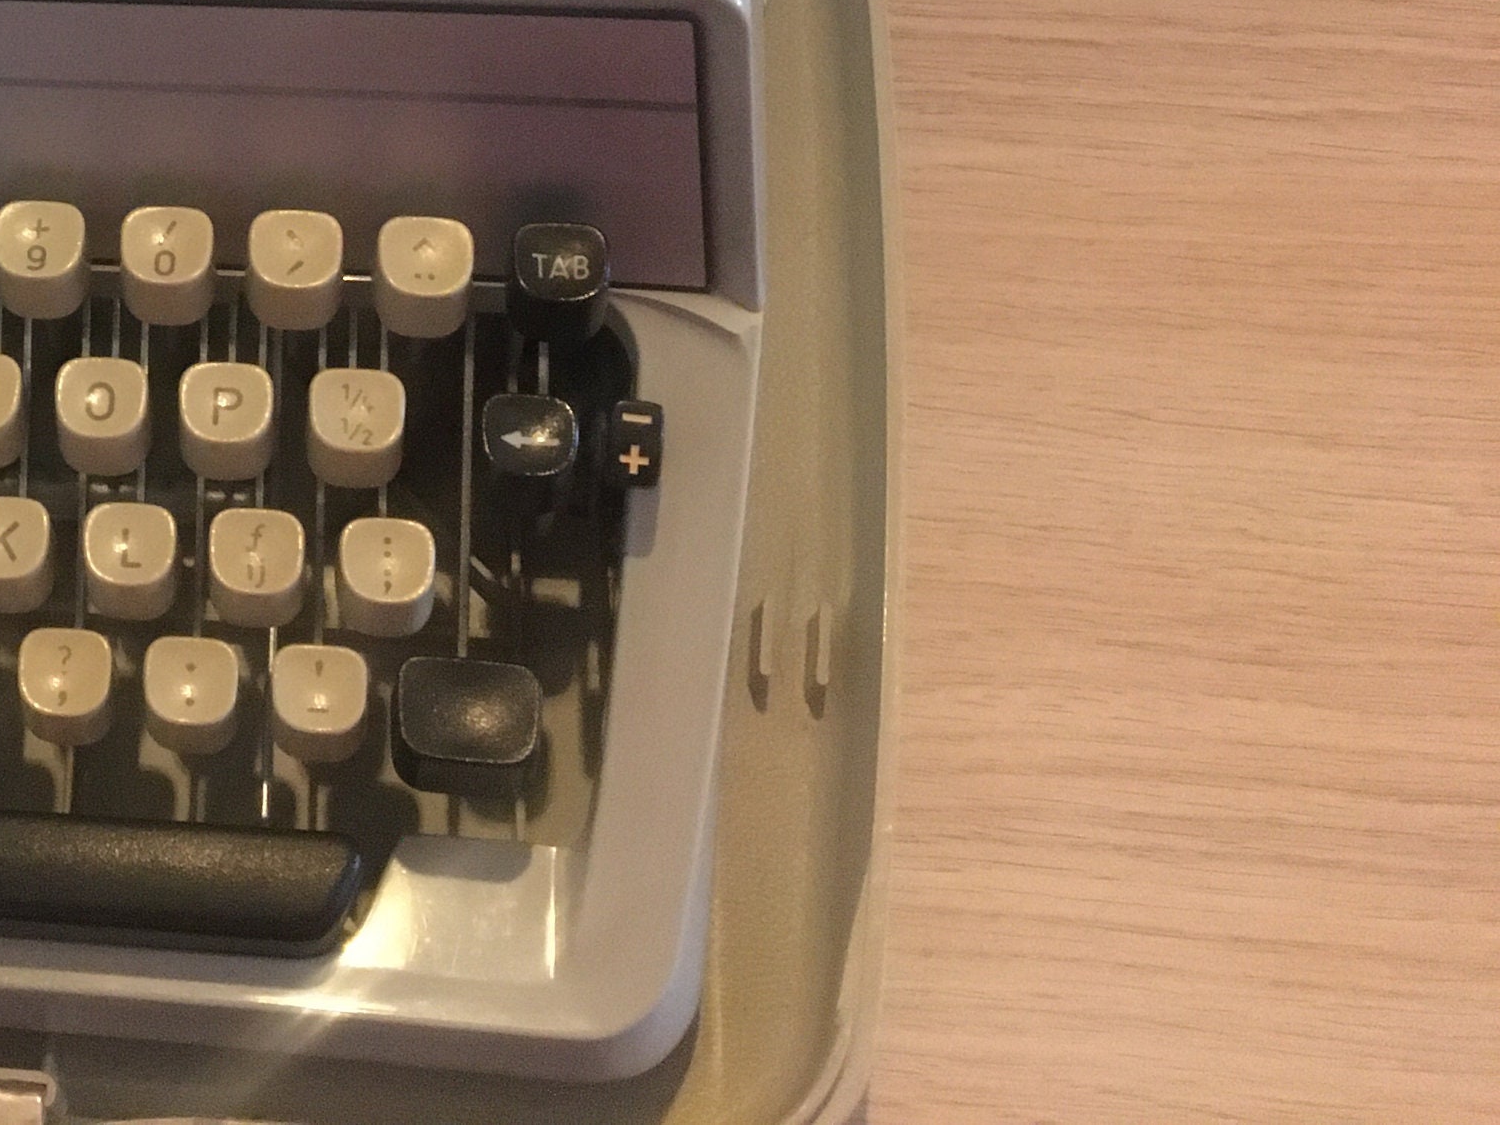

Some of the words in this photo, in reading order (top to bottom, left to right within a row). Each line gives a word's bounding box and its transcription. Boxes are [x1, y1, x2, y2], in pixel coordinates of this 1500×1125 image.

[26, 244, 48, 271] 9
[531, 251, 591, 280] TAB
[84, 381, 116, 422] O
[211, 386, 243, 426] P
[118, 527, 143, 569] L
